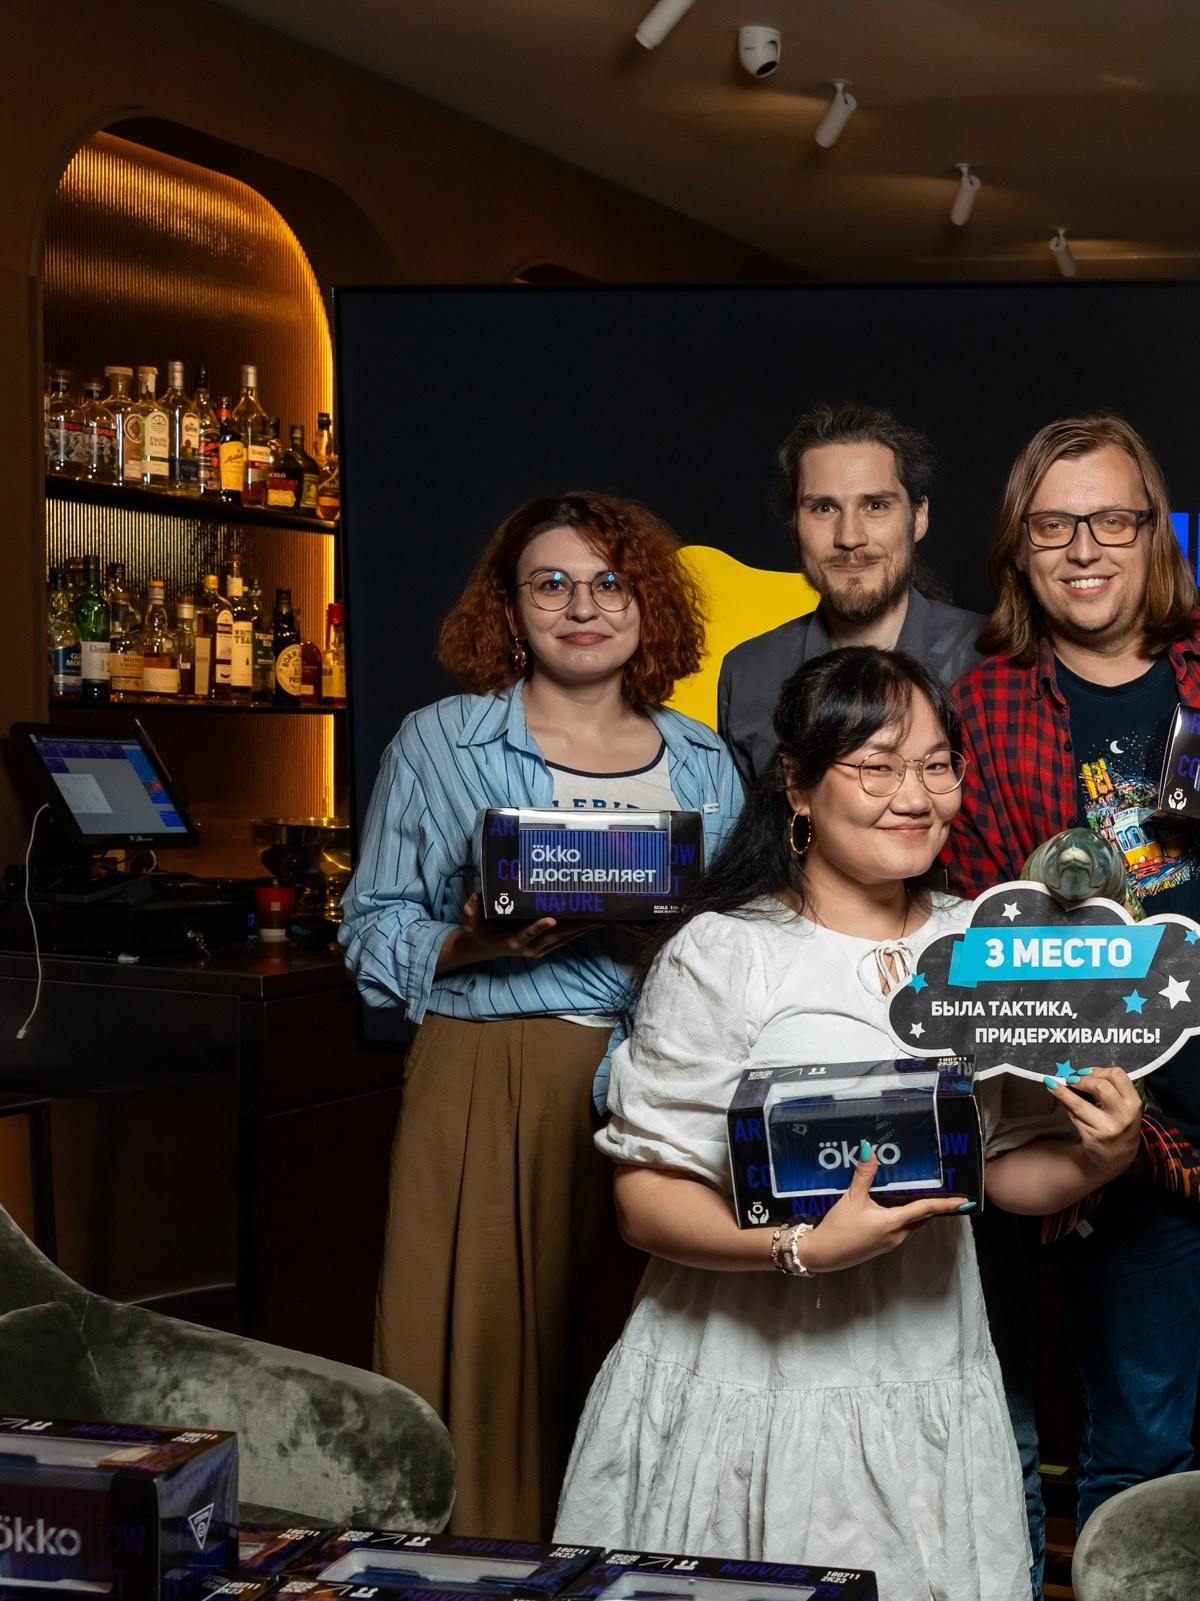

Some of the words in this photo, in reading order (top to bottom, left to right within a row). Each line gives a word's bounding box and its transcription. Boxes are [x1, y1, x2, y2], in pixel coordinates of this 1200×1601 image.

[531, 844, 581, 863] ökko
[530, 868, 657, 884] доставляет
[984, 938, 1005, 968] 3
[1012, 938, 1133, 968] МЕСТО
[931, 1001, 986, 1017] БЫЛА
[988, 1001, 1078, 1019] ТАКТИКА,
[975, 1027, 1161, 1046] ПРИДЕРЖИВАЛИСЬ!
[450, 1538, 541, 1554] MOVIES
[556, 1546, 590, 1555] 180711
[549, 1551, 577, 1559] 2K23
[719, 1562, 811, 1579] MOVIES
[826, 1570, 861, 1580] 180711
[819, 1576, 848, 1584] 2K23
